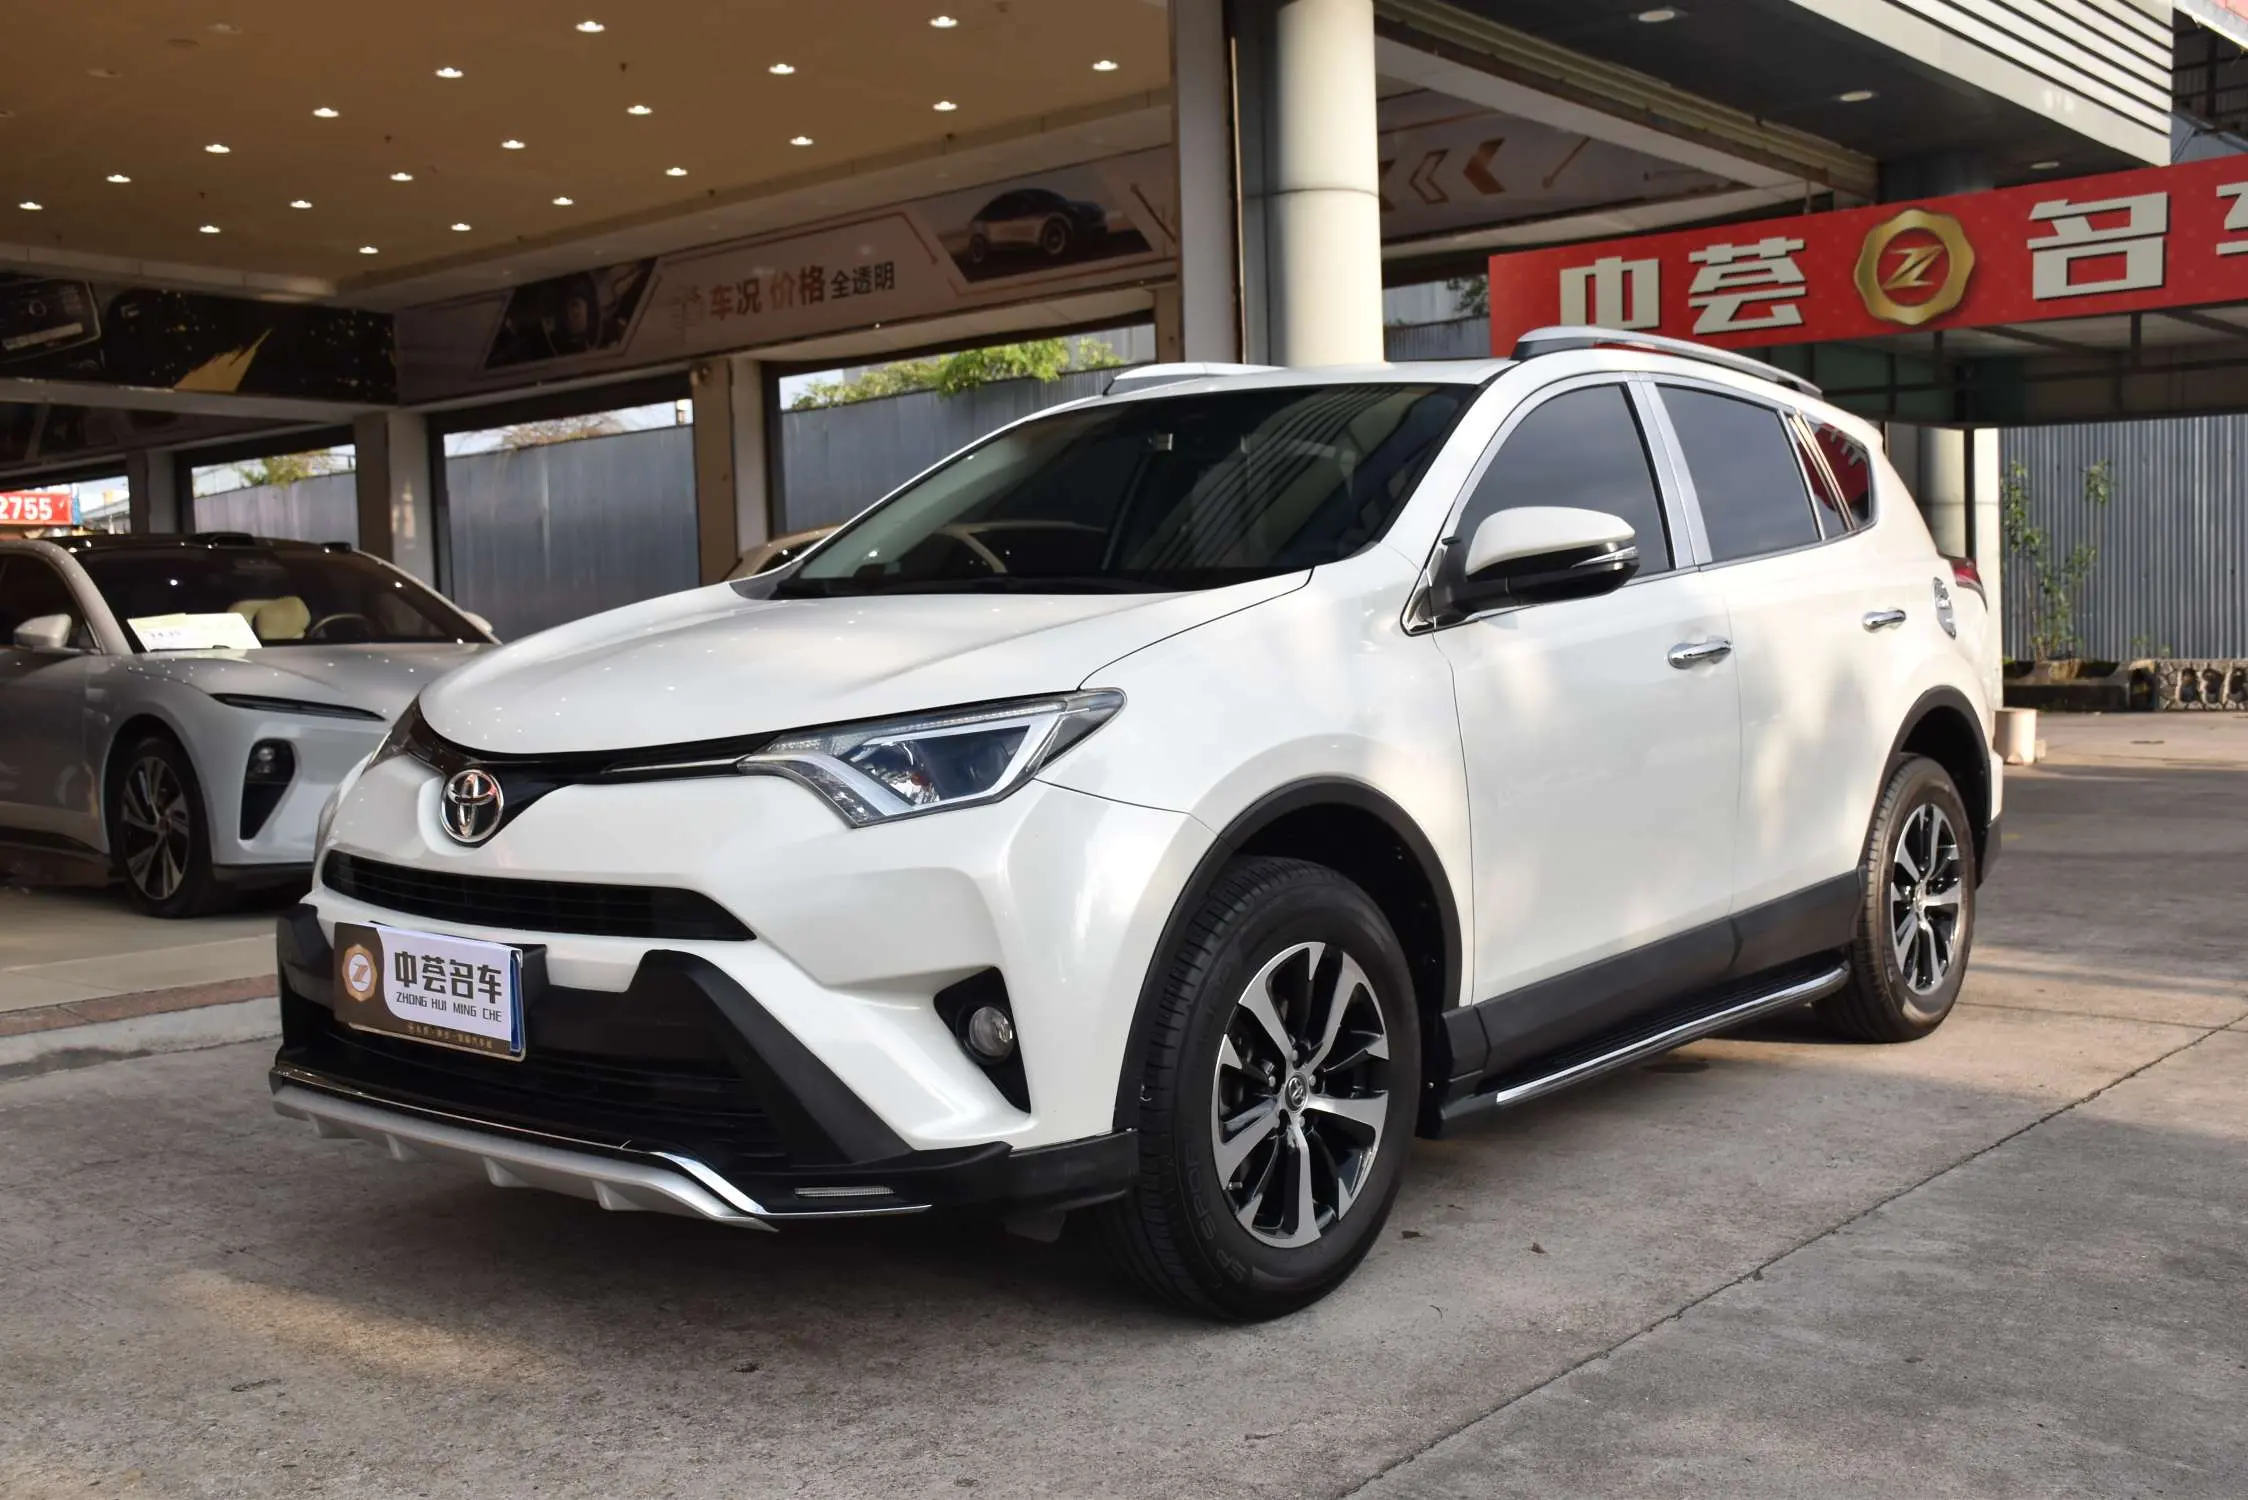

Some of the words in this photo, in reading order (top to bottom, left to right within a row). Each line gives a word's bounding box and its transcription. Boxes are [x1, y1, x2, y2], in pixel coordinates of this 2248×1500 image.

[2027, 181, 2248, 300] 名
[395, 951, 503, 1003] 中荟名车
[396, 991, 428, 1008] ZHONG
[431, 997, 447, 1012] HUI
[453, 1004, 477, 1018] MING
[482, 1007, 502, 1023] CHE
